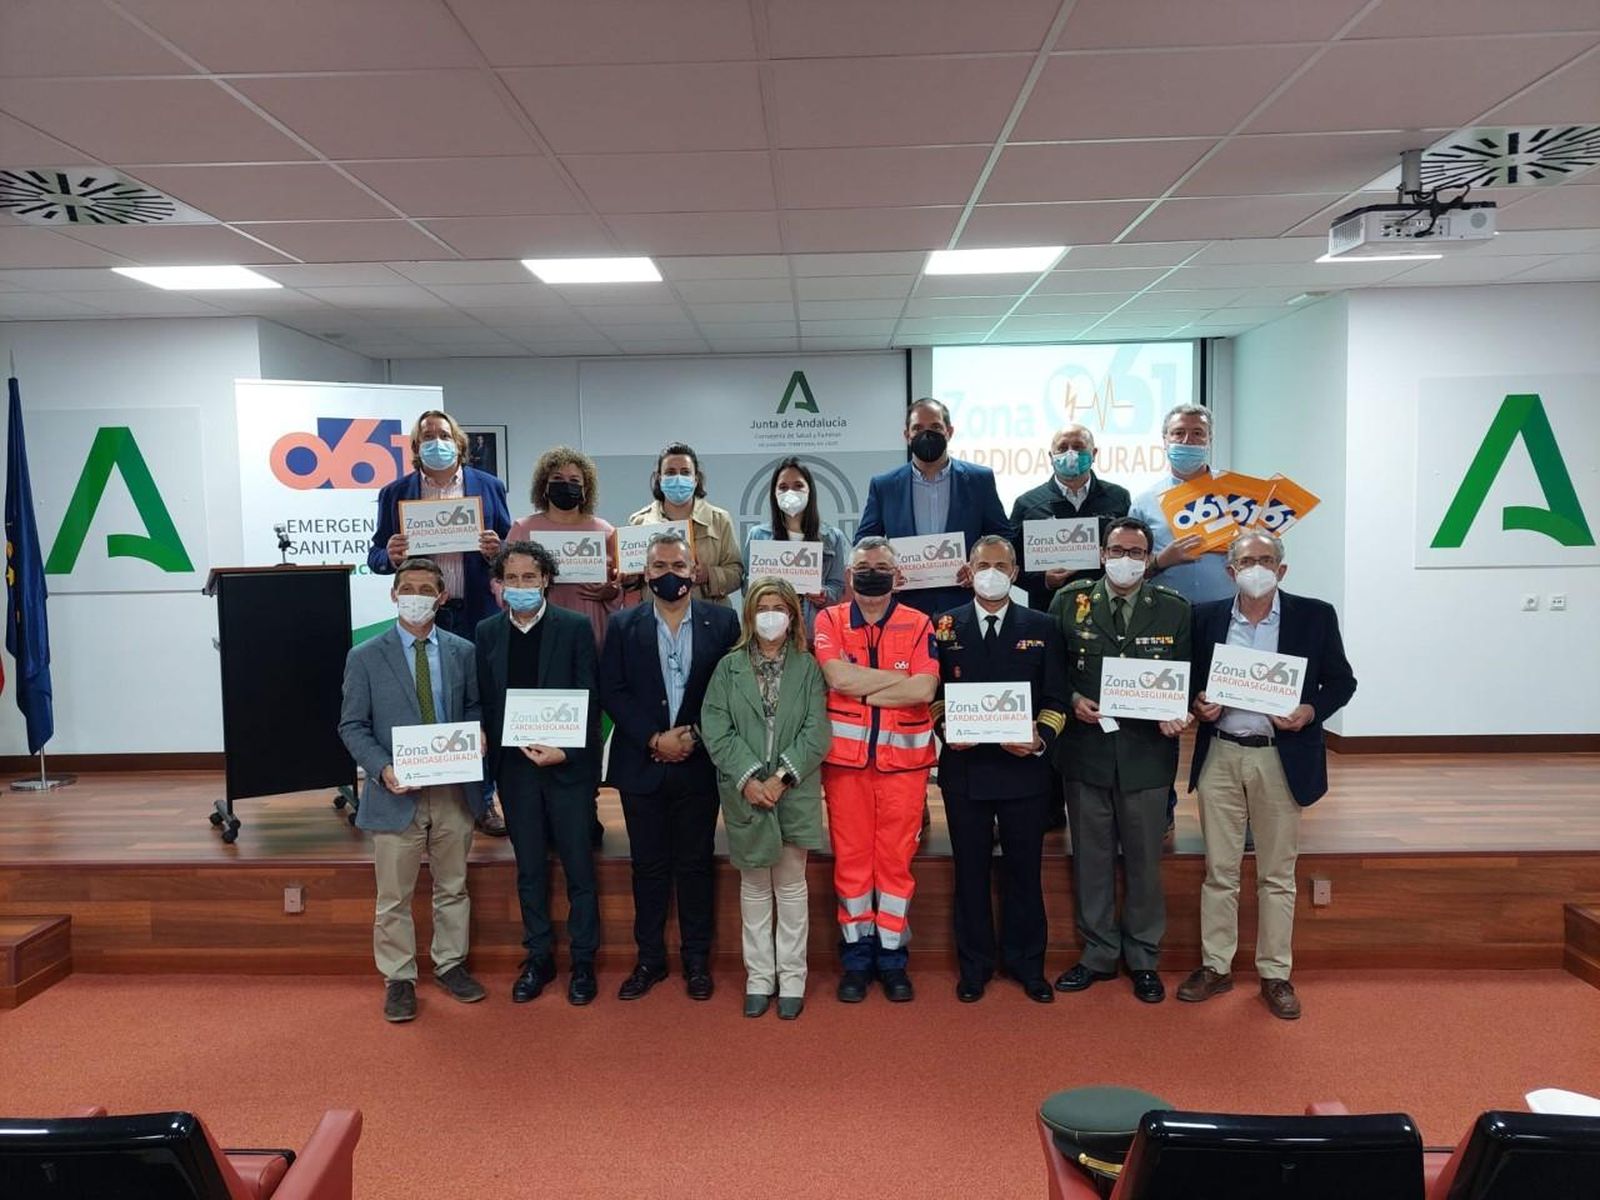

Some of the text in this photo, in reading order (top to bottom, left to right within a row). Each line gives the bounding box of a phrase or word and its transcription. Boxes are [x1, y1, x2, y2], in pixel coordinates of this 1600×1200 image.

[750, 420, 778, 429] Junta
[781, 419, 794, 429] de
[1173, 494, 1229, 529] 061
[406, 518, 434, 529] Zona
[621, 540, 647, 550] Zona
[1027, 535, 1054, 545] Zona
[752, 554, 778, 566] Zona
[1213, 661, 1246, 678] Zona
[1104, 675, 1136, 688] Zona
[1211, 674, 1297, 697] CARDIOASEGURADA
[1103, 688, 1185, 700] CARDIOASEGURADA
[948, 701, 978, 713] Zona
[511, 711, 538, 722] Zona
[396, 744, 428, 757] Zona
